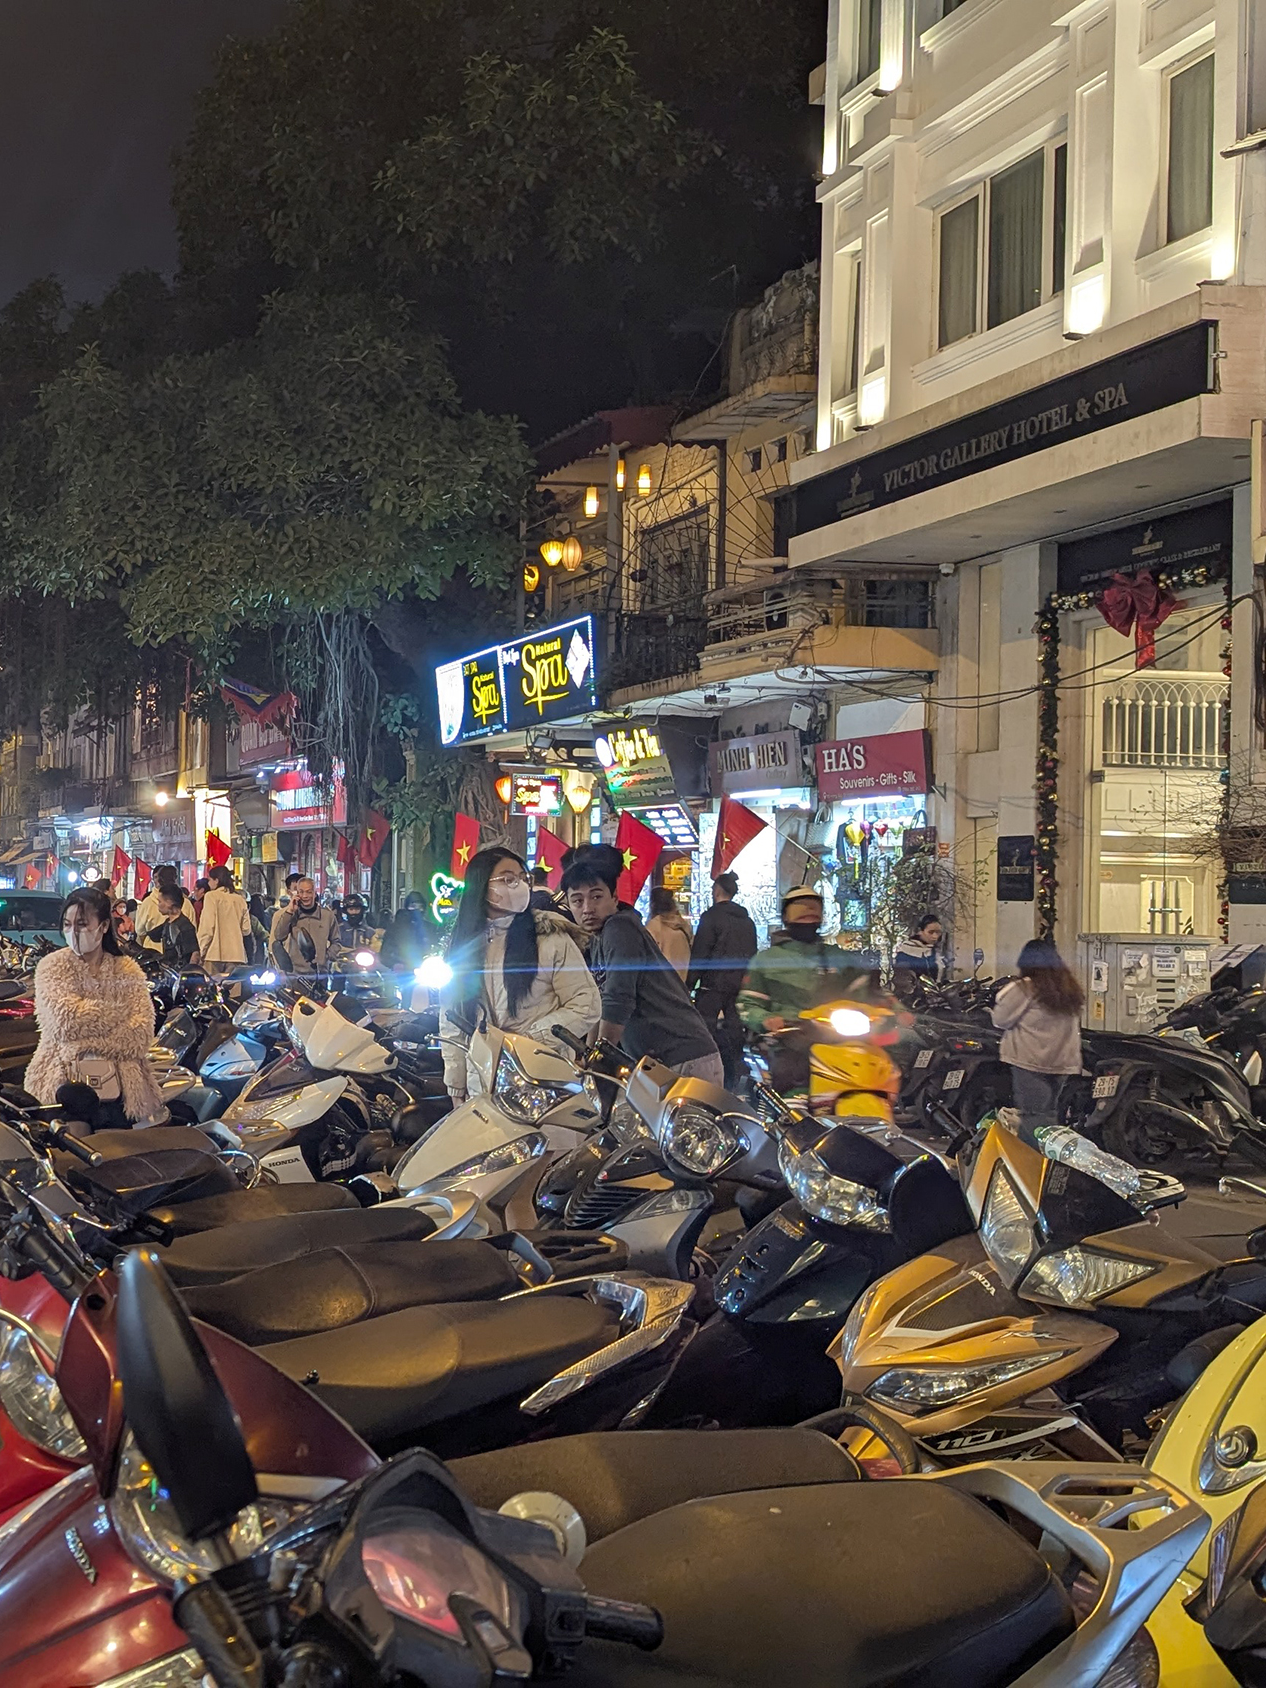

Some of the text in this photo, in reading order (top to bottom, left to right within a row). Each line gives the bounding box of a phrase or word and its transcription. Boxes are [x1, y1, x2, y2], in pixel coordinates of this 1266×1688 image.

[884, 383, 1129, 492] VICTOR GALLERY HOTEL & SPA
[536, 637, 561, 656] Natural
[521, 643, 568, 715] Spa
[472, 675, 500, 725] Spa
[608, 731, 636, 768] Coffee
[640, 728, 660, 757] Tea
[716, 747, 750, 773] MINH
[822, 742, 866, 773] HA'S
[840, 776, 875, 789] Souvenirs
[880, 773, 897, 786] Gifts
[903, 771, 916, 783] Silk
[268, 1157, 301, 1168] HONDA
[65, 1526, 96, 1584] HONDA
